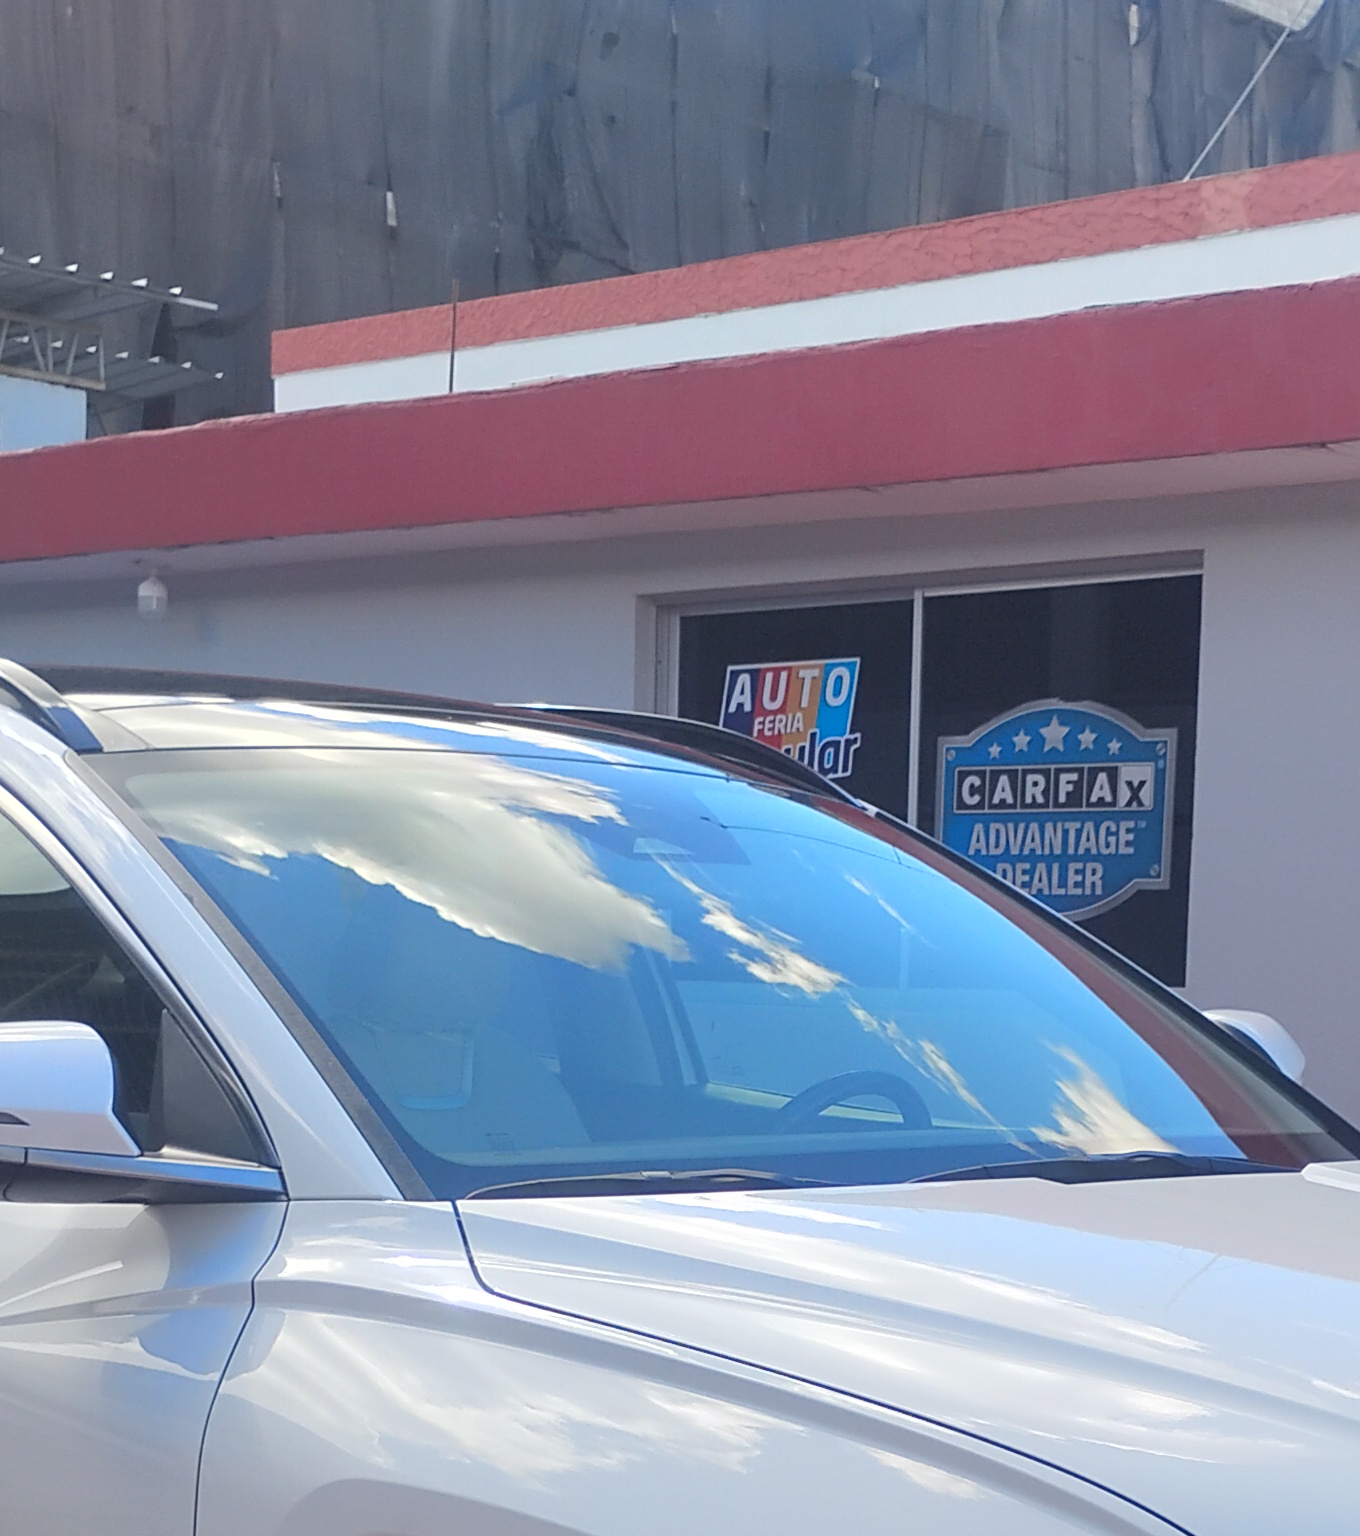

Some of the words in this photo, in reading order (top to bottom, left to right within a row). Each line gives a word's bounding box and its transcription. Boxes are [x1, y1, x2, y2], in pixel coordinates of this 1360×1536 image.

[728, 666, 851, 714] AUTO
[752, 712, 804, 738] FERIA
[961, 771, 1148, 808] CARFAX
